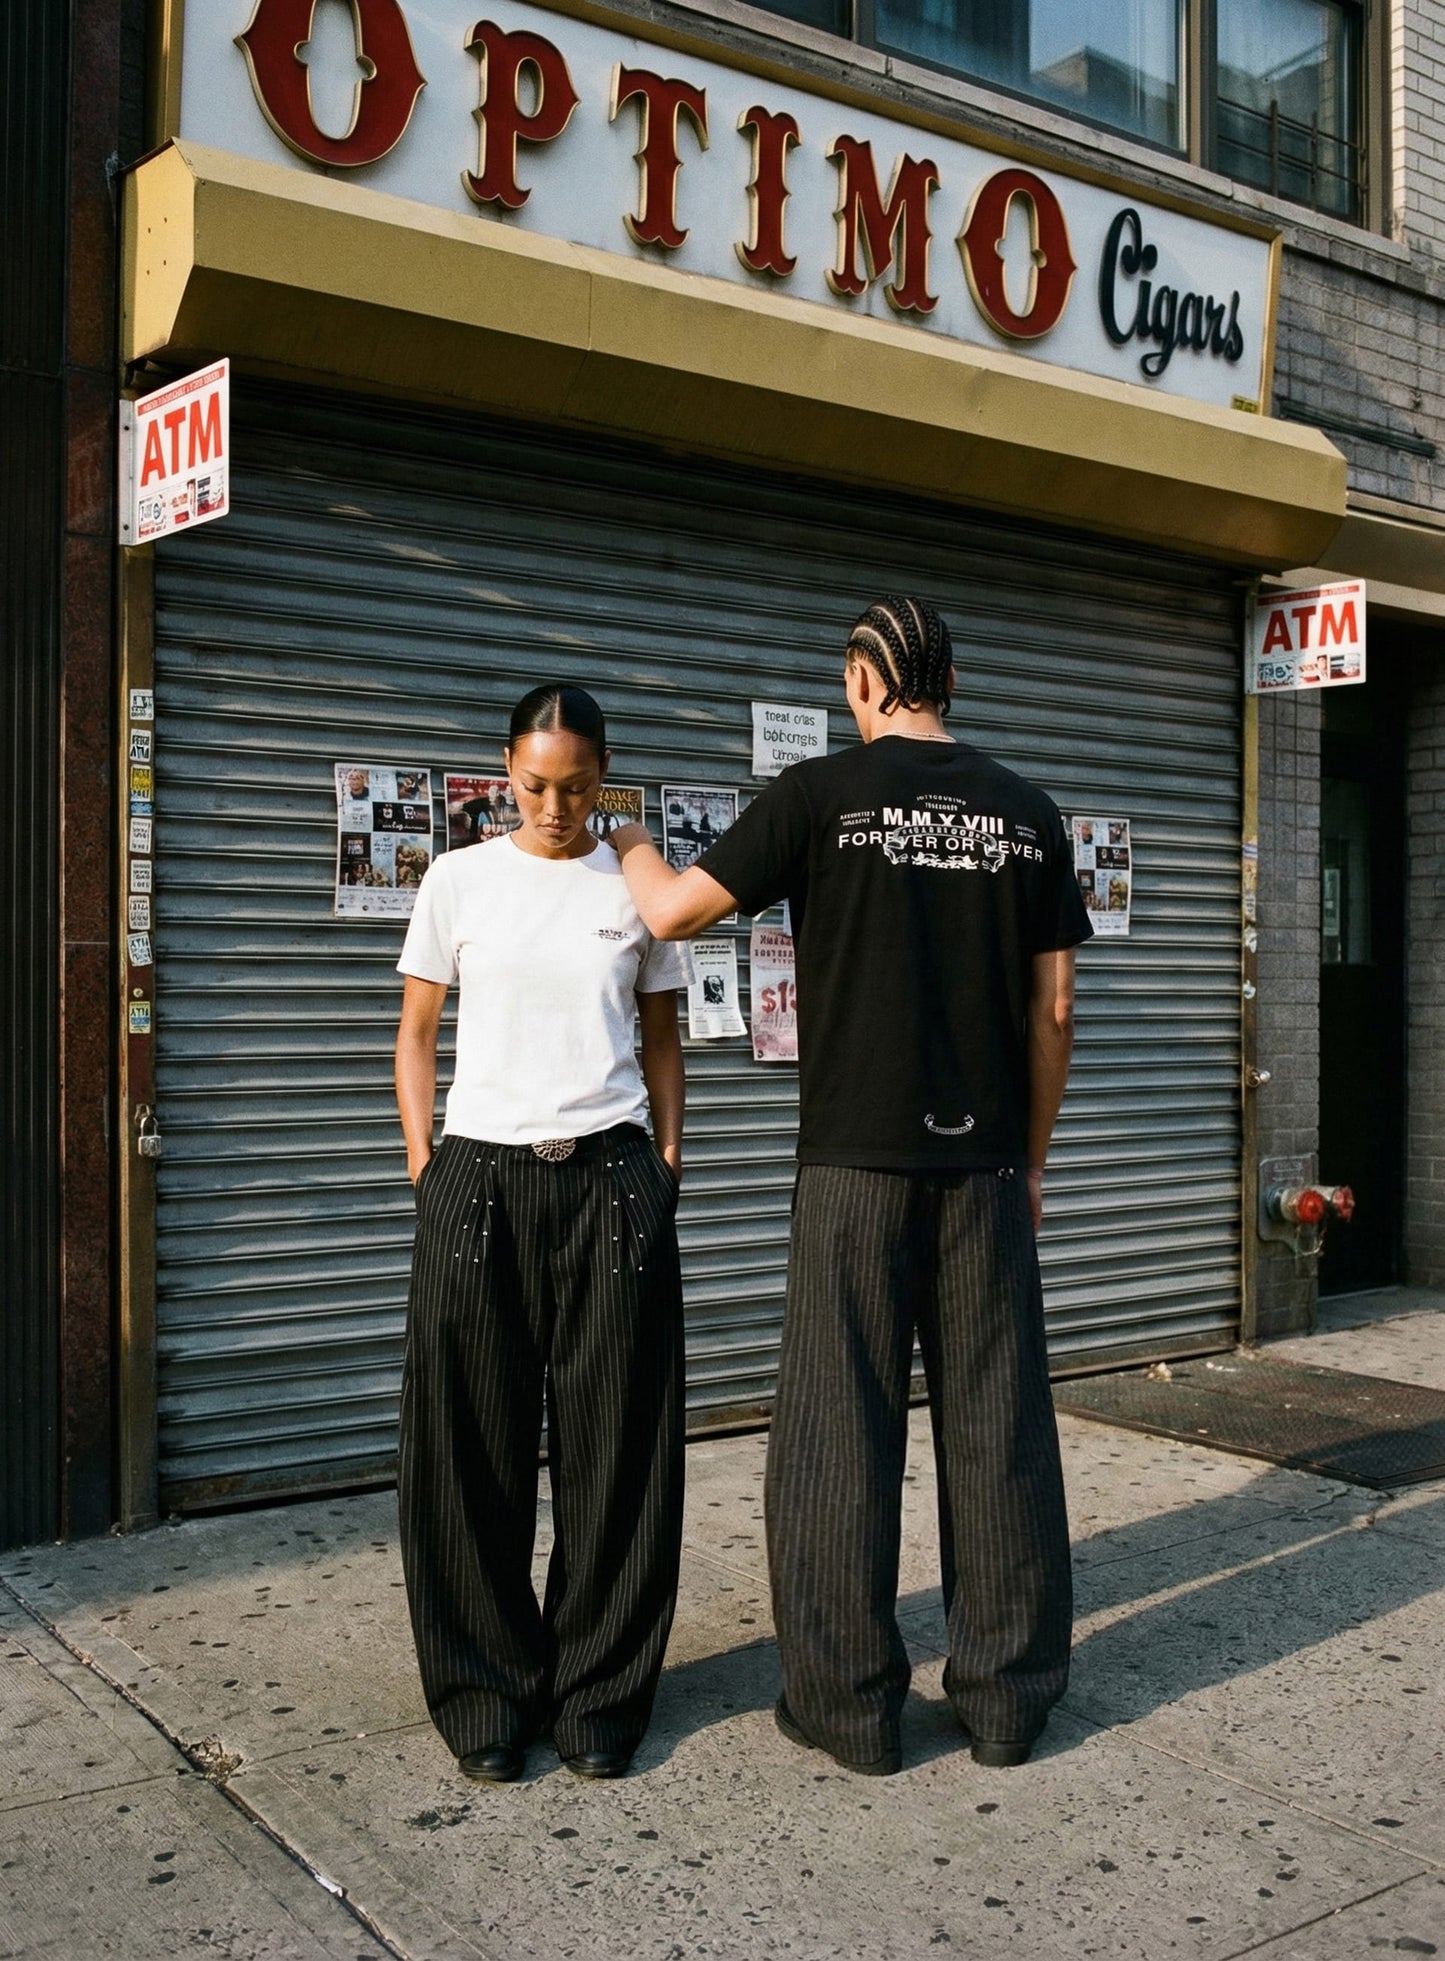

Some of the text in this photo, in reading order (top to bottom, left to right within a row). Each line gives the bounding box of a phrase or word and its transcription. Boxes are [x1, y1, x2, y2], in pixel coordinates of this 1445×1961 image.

[234, 0, 1245, 379] OPTIMO Cigars
[140, 391, 223, 488] ATM
[1261, 600, 1359, 655] ATM
[838, 830, 938, 849] FOREER
[945, 837, 975, 851] OR
[998, 840, 1044, 863] EVER
